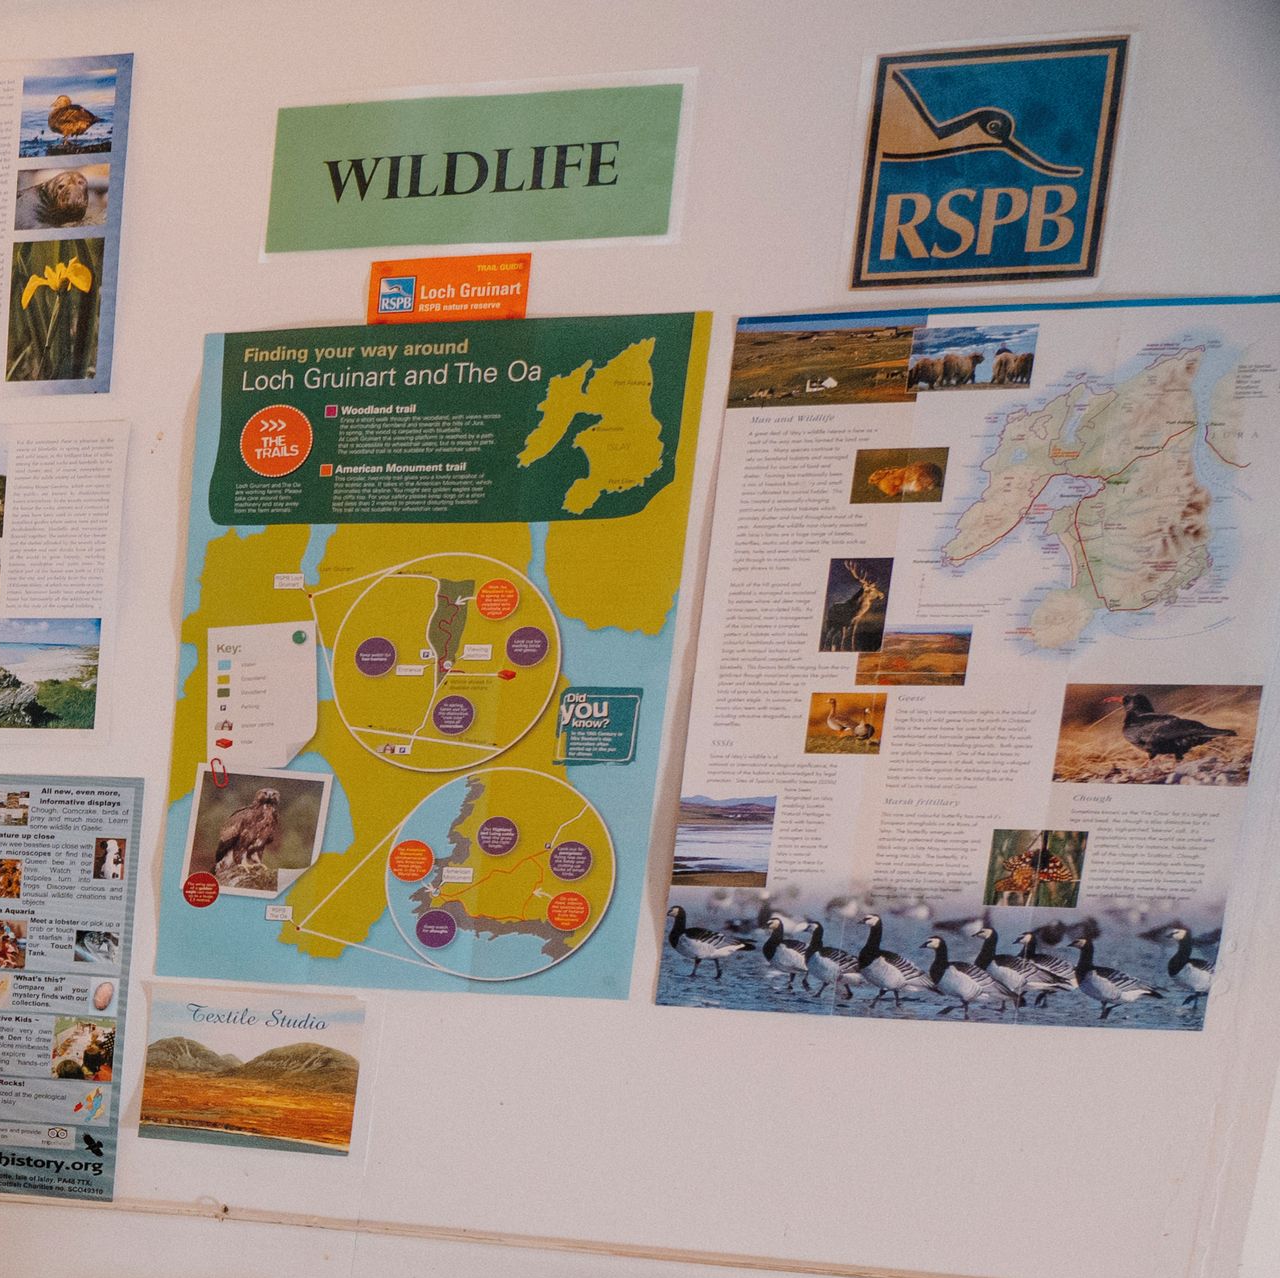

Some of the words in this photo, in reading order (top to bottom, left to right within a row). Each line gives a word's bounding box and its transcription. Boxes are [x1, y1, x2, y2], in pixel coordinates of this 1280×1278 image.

[323, 140, 621, 204] WILDLIFE
[879, 185, 1079, 262] RSPB
[499, 263, 524, 271] GUIDE
[420, 284, 456, 299] Loch
[460, 282, 522, 297] Gruinart
[381, 297, 412, 310] RSPB
[418, 303, 441, 312] RSPB
[442, 303, 468, 311] nature
[470, 302, 501, 310] reserve
[244, 347, 309, 363] Finding
[314, 346, 355, 362] your
[361, 343, 397, 360] way
[403, 338, 469, 356] around
[242, 369, 294, 391] Loch
[303, 366, 397, 389] Gruinart
[404, 364, 448, 386] and
[454, 362, 498, 383] The
[508, 360, 541, 382] Oa
[341, 405, 393, 415] Woodland
[395, 404, 417, 414] trail
[262, 435, 286, 448] THE
[255, 445, 299, 459] TRAILS
[335, 464, 383, 474] American
[385, 463, 443, 473] Monument
[445, 462, 466, 472] trail
[216, 644, 242, 655] Key:
[567, 693, 587, 702] Did
[560, 701, 609, 726] you
[572, 718, 610, 728] know?
[40, 798, 85, 806] informative
[88, 799, 121, 808] displays
[187, 1002, 259, 1026] Textile
[265, 1008, 330, 1030] Studio
